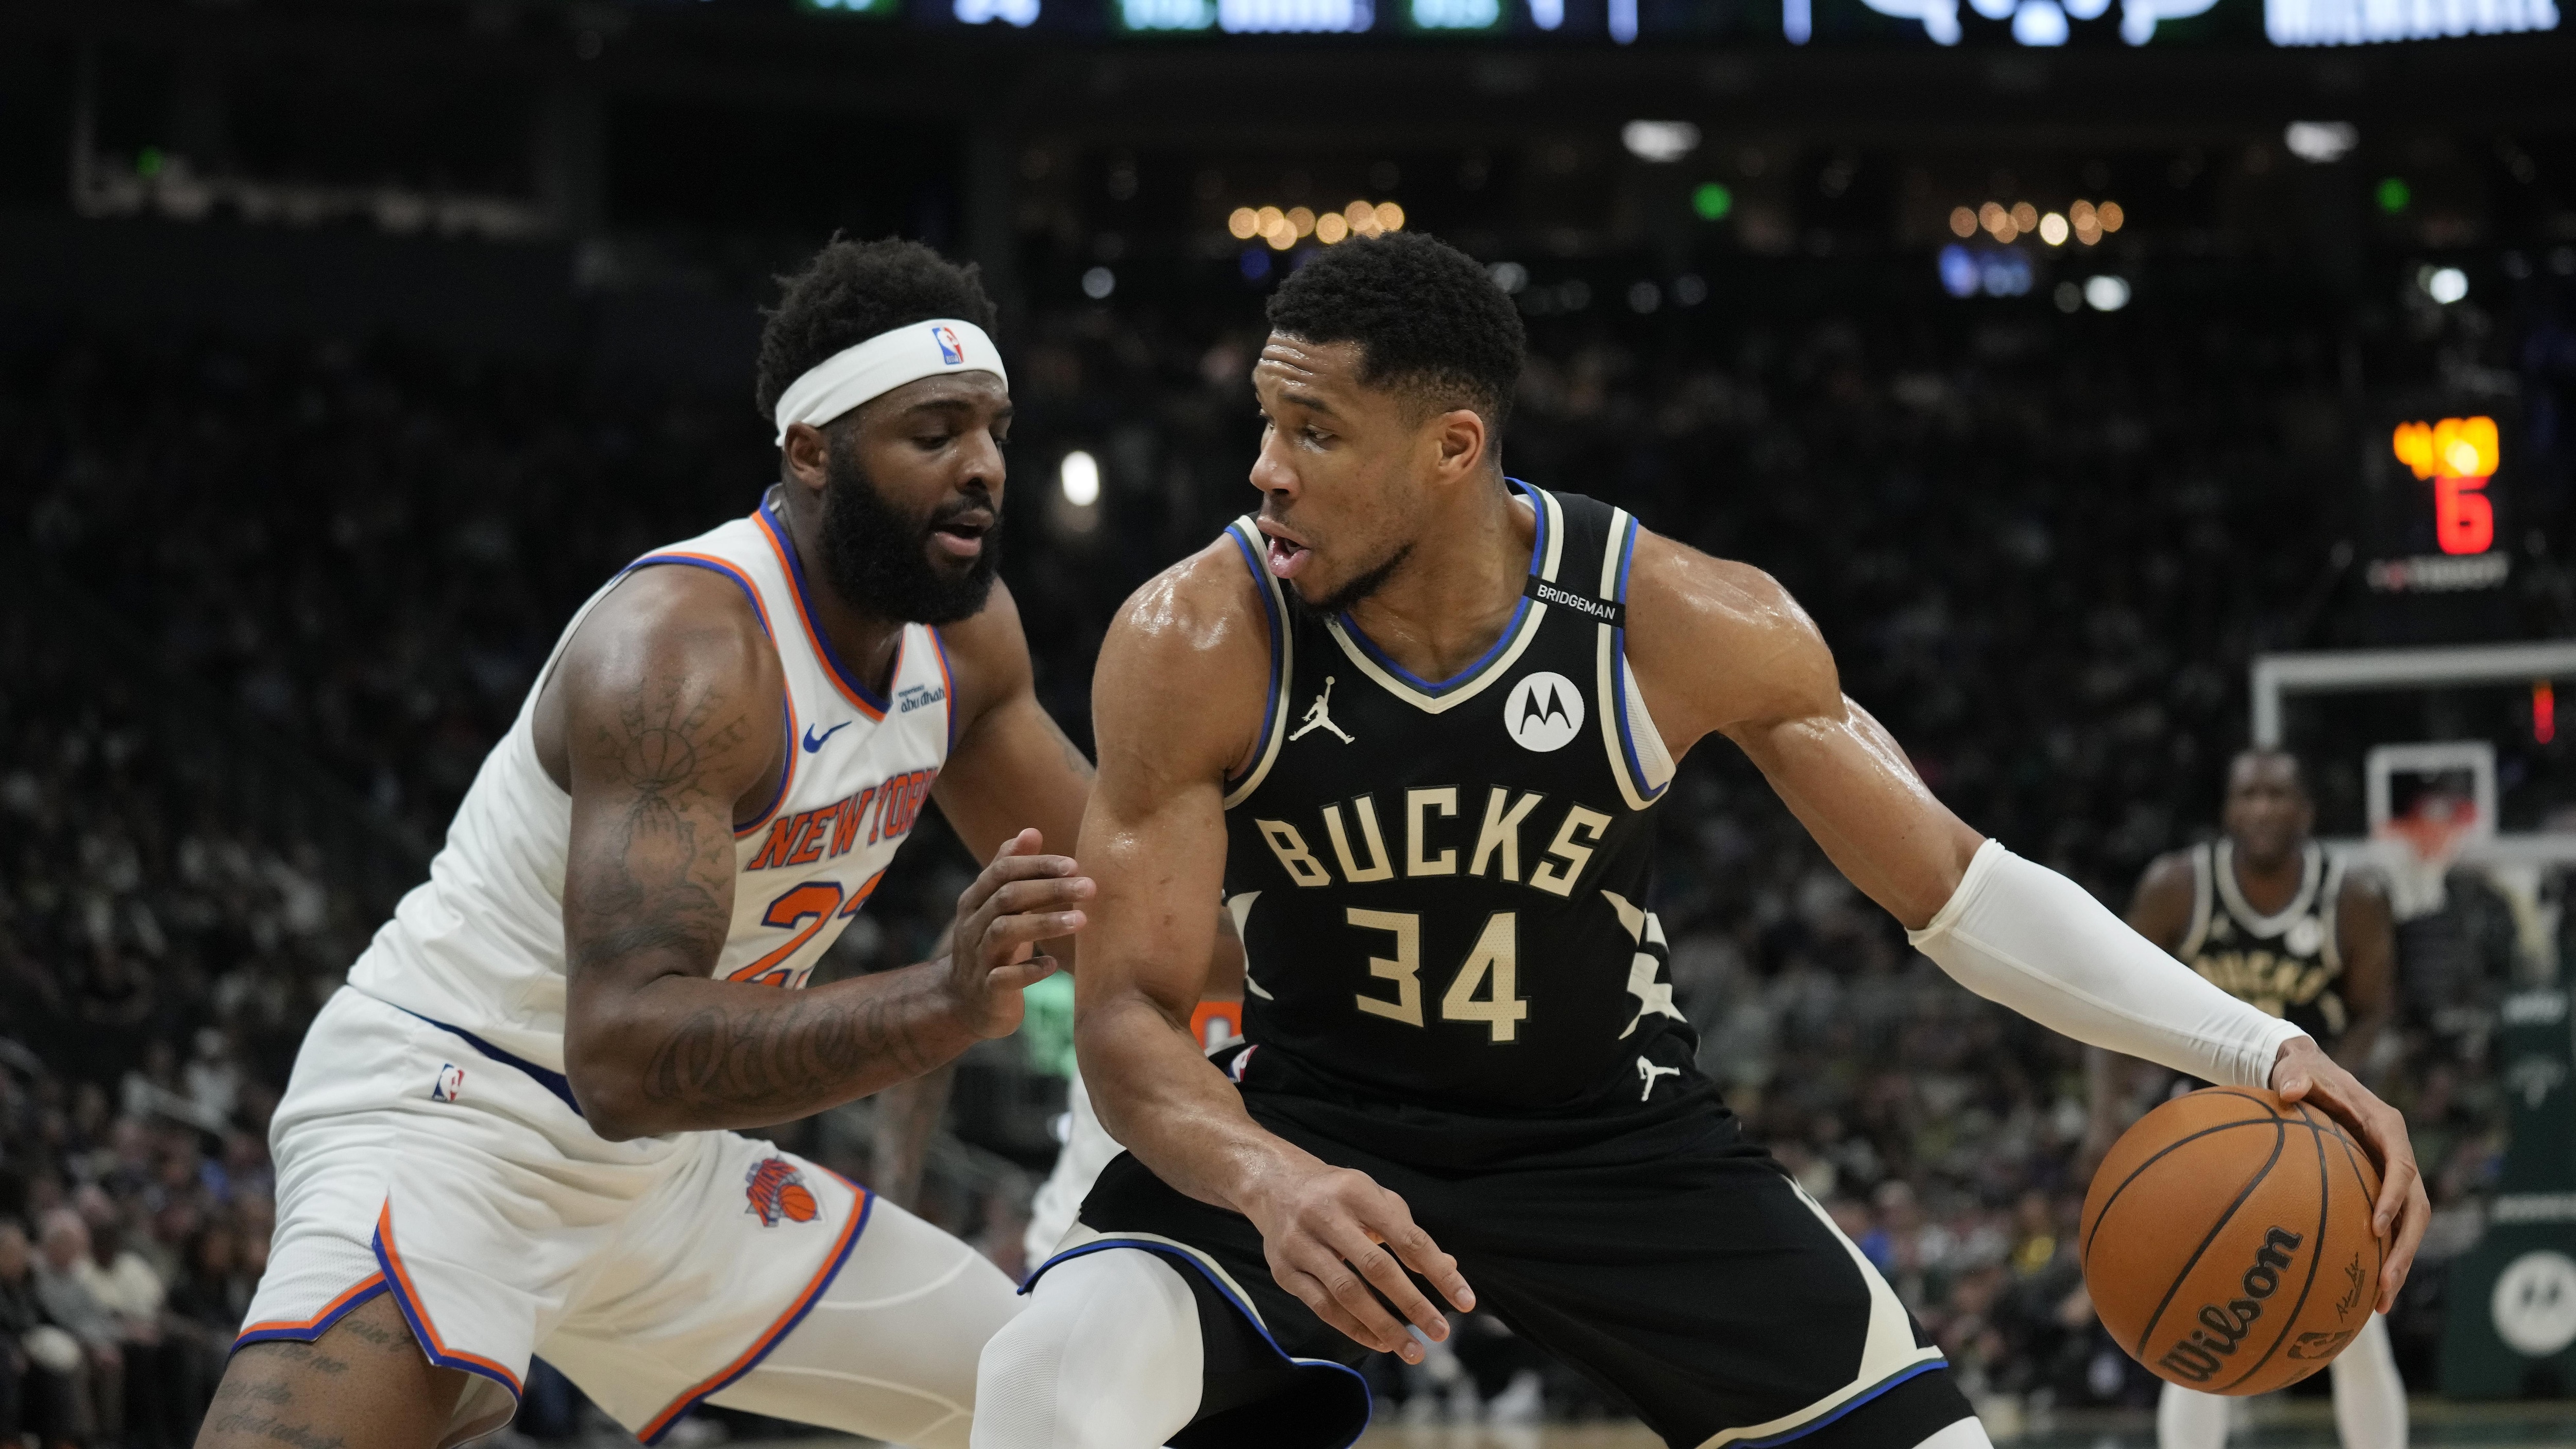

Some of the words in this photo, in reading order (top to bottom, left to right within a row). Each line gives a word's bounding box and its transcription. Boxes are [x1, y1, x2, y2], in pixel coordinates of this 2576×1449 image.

[1536, 584, 1616, 620] BRIDGEMAN
[920, 687, 945, 706] dhab
[743, 786, 876, 872] NEW
[1254, 783, 1614, 898] BUCKS
[725, 867, 888, 989] 2
[1346, 907, 1532, 1046] 34
[2157, 1225, 2303, 1383] Wilson
